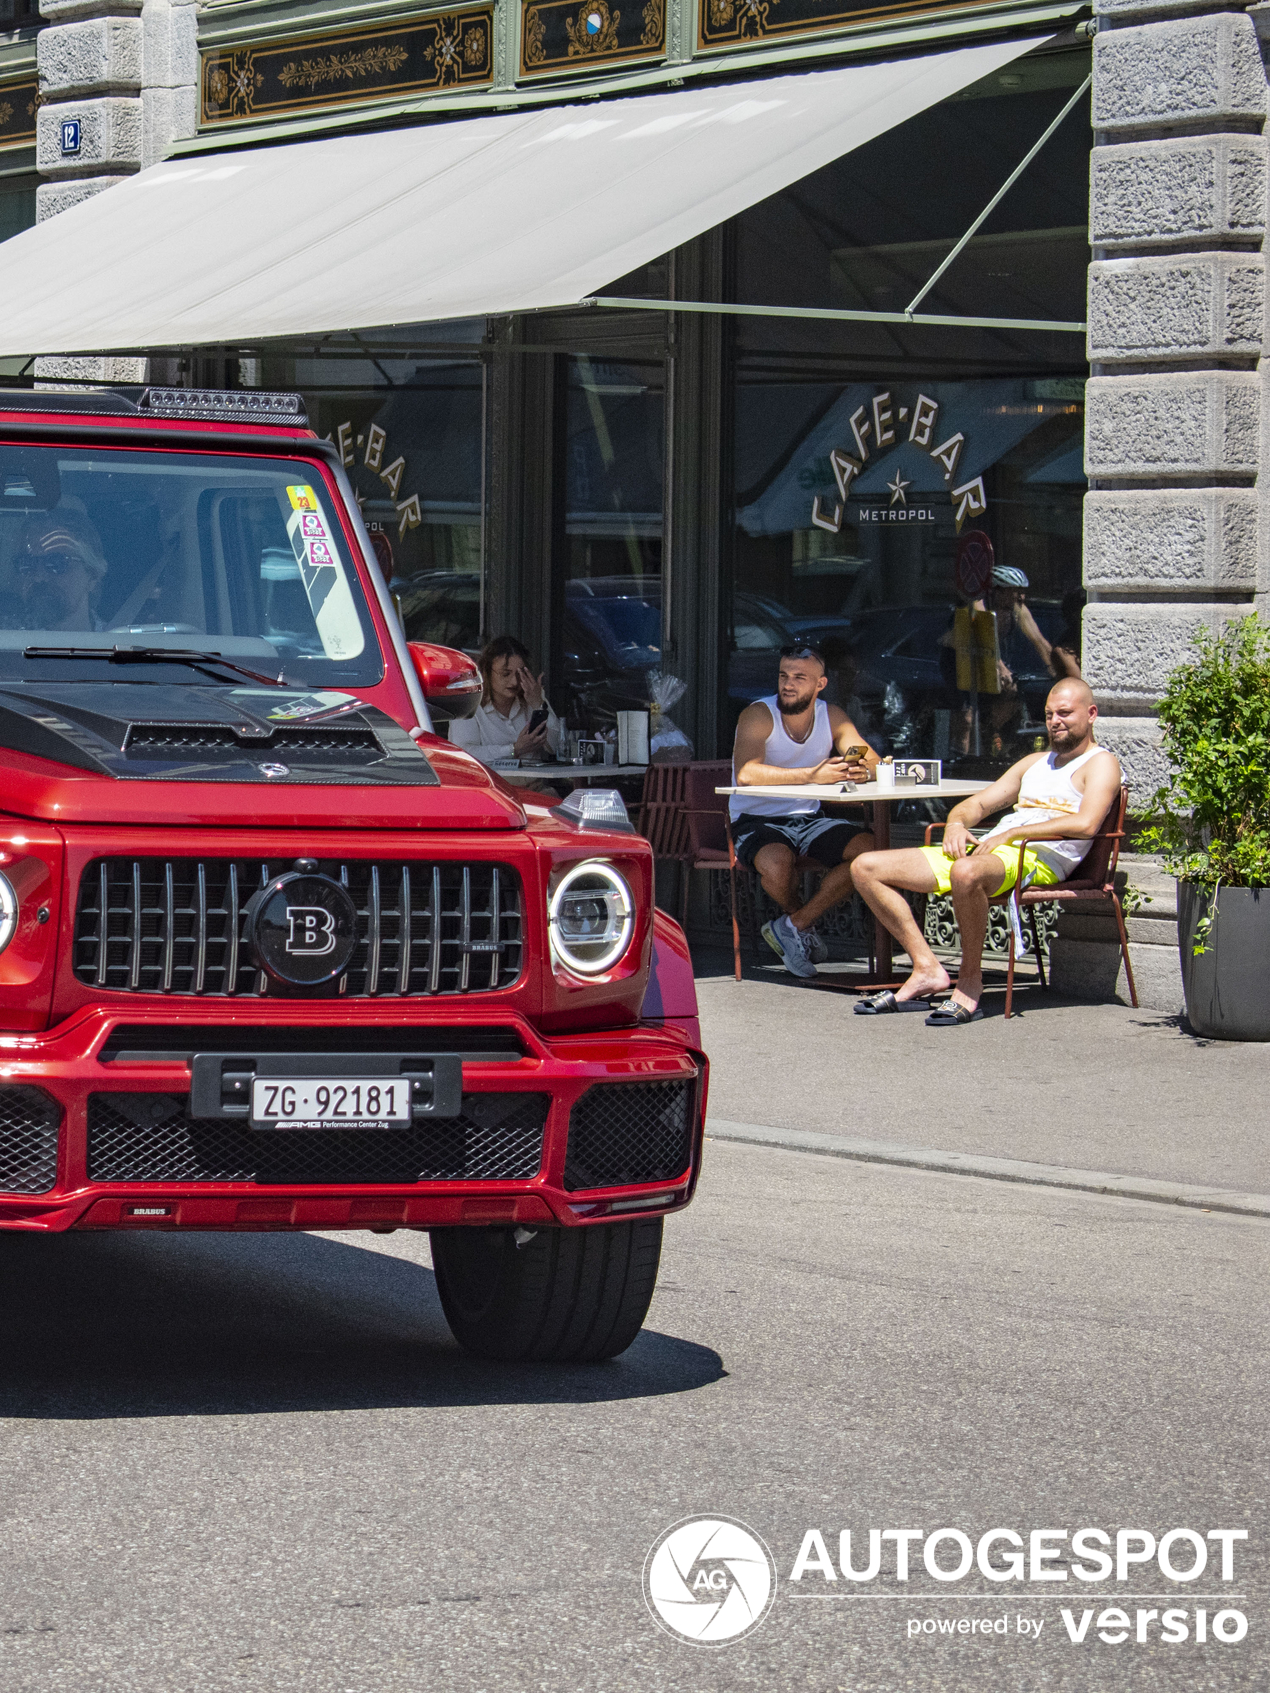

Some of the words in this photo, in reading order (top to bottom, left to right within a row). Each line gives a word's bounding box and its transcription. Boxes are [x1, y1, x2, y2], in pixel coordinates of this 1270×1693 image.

[64, 125, 75, 148] 12
[297, 496, 310, 508] 23
[286, 906, 336, 955] B
